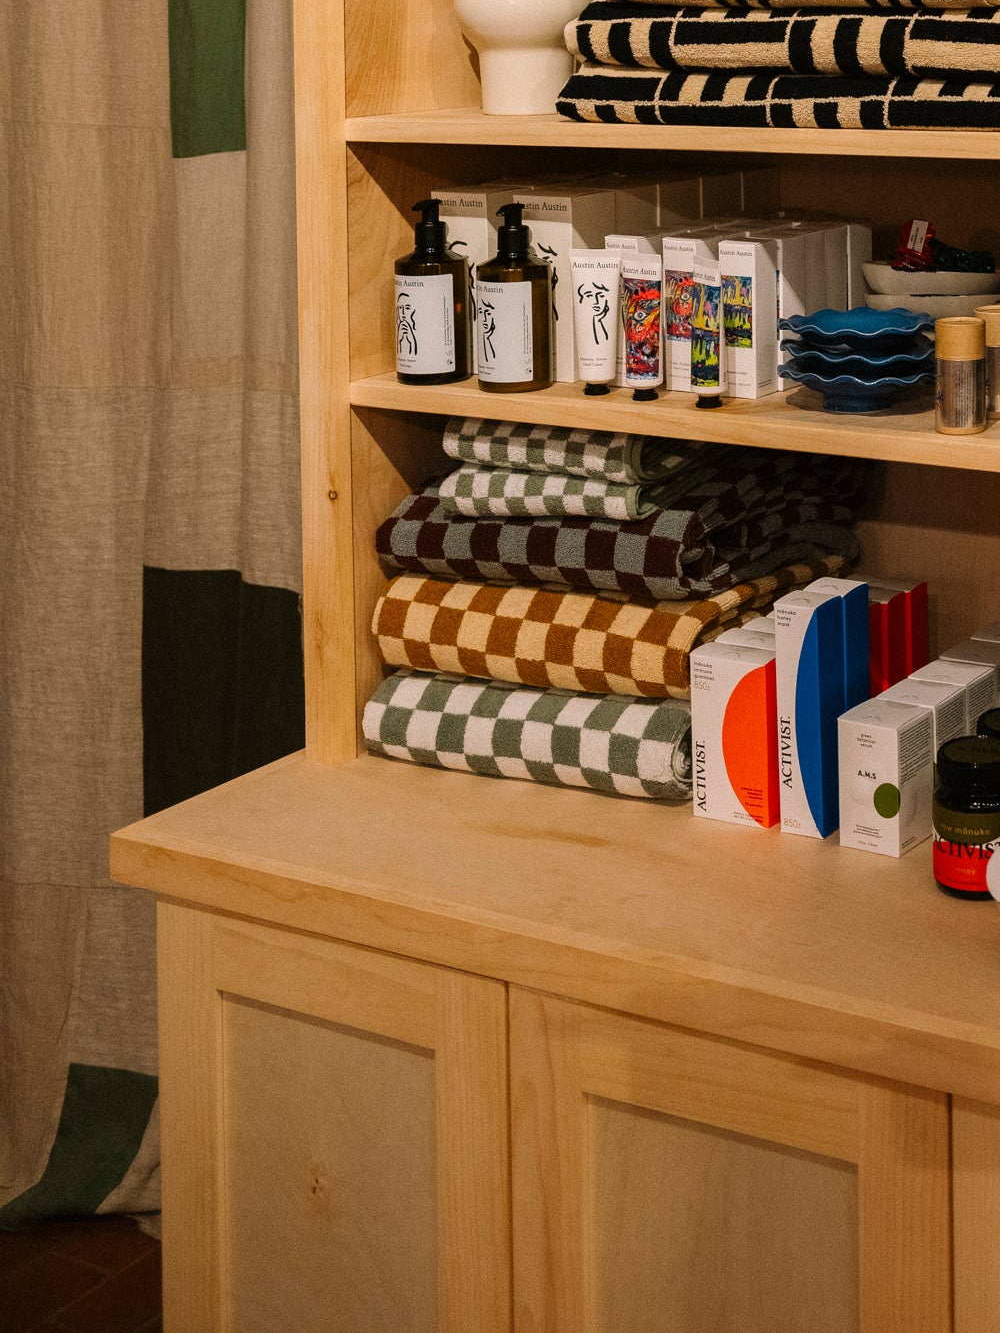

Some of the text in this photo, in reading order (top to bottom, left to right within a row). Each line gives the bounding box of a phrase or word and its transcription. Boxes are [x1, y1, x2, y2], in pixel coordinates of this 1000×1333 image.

[459, 198, 483, 208] Austin
[541, 201, 568, 212] Austin
[620, 242, 636, 250] Austin
[678, 244, 694, 253] Austin
[736, 250, 753, 258] Austin
[572, 261, 619, 269] Austin Austin
[622, 266, 657, 276] Austin Austin
[403, 279, 424, 287] Austin
[483, 285, 504, 293] Austin
[694, 674, 715, 682] gummies
